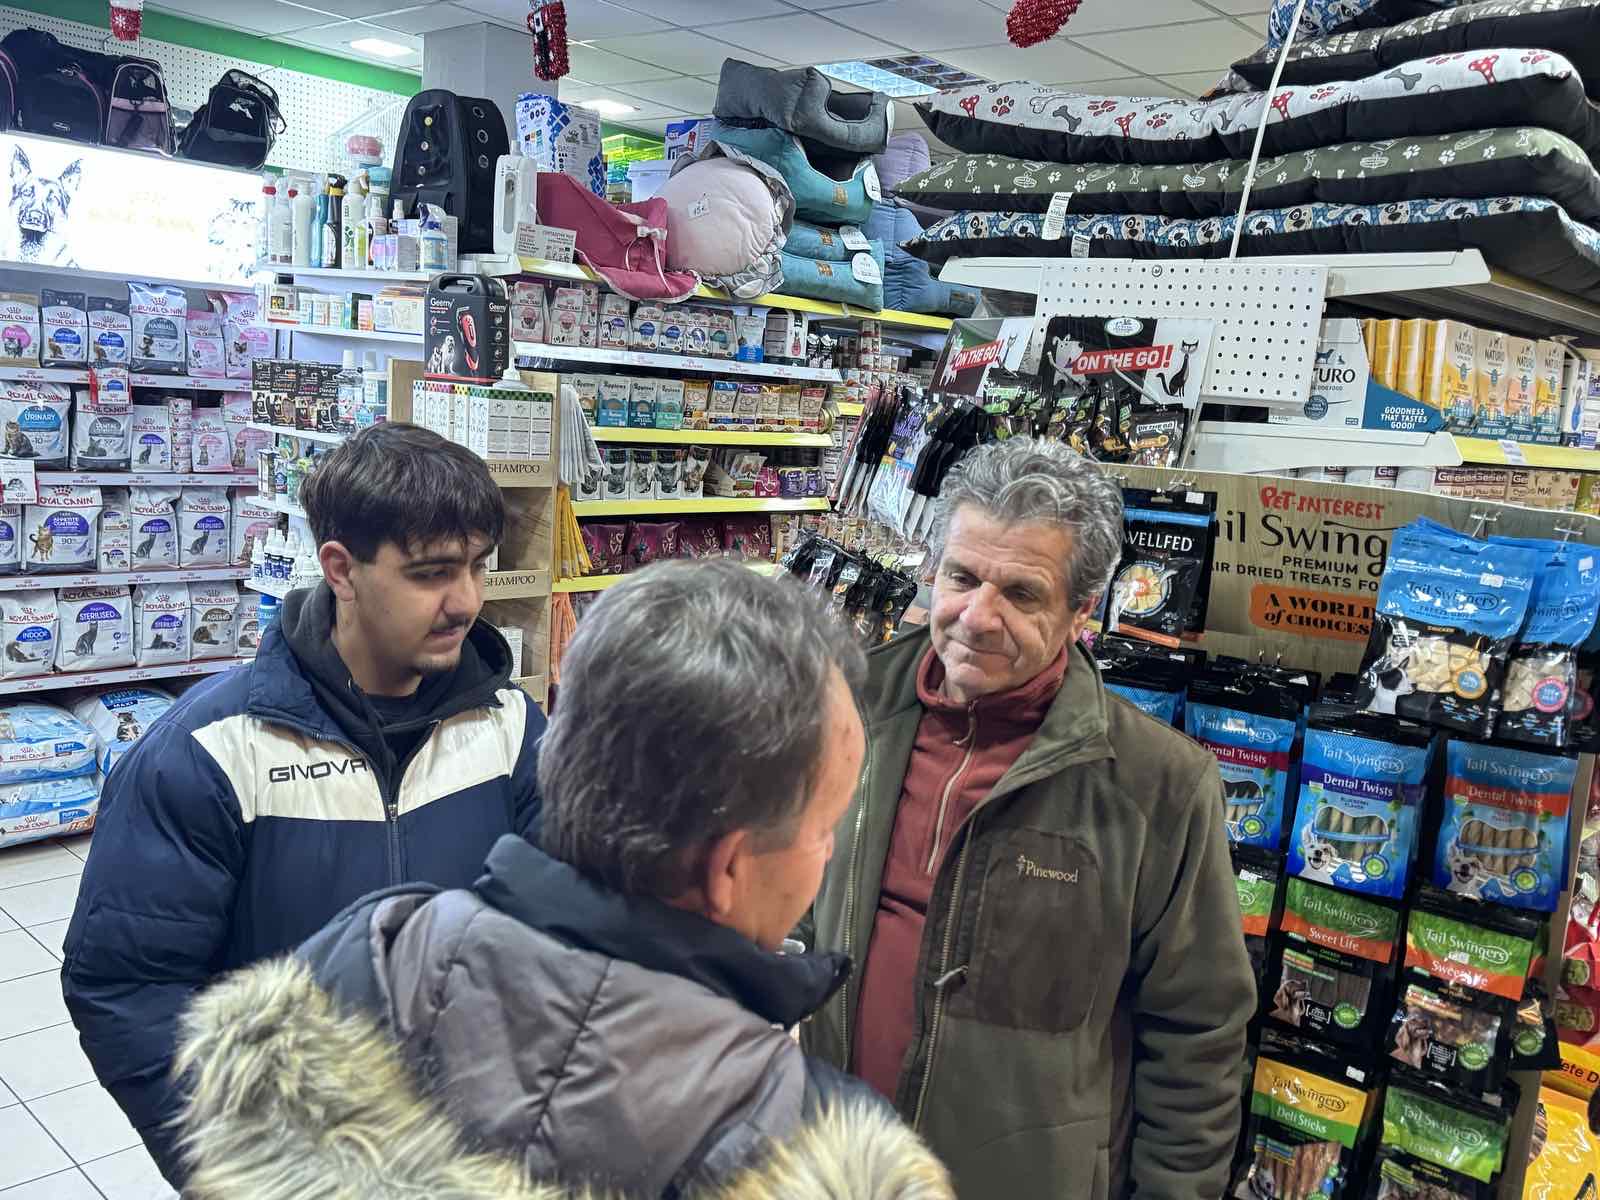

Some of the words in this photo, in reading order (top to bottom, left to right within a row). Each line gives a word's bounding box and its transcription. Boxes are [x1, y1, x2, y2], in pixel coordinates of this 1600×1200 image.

[955, 354, 964, 368] ON
[965, 350, 981, 365] THE
[1077, 355, 1100, 371] ON
[1104, 352, 1133, 369] THE
[1313, 368, 1356, 383] TURO
[25, 411, 55, 421] URINARY
[1381, 413, 1398, 422] THAT
[1399, 415, 1428, 424] TASTES
[1384, 406, 1425, 415] GOODNESS
[1391, 422, 1415, 430] GOOD!
[488, 463, 541, 474] SHAMPOO
[40, 497, 62, 506] OYAL
[64, 497, 94, 506] CANIN
[1121, 529, 1193, 552] WELLFED
[1261, 514, 1388, 577] Swing
[1282, 556, 1359, 575] PREMIUM
[484, 575, 536, 587] SHAMPOO
[1211, 562, 1230, 573] IR
[1237, 564, 1283, 579] DRIED
[1289, 571, 1351, 588] TREATS
[1358, 580, 1378, 592] FO
[1408, 581, 1431, 596] Tail
[1266, 593, 1280, 607] A
[1264, 609, 1284, 624] of
[1286, 613, 1369, 635] CHOICES
[1203, 743, 1235, 758] Dental
[1237, 749, 1267, 764] Twists
[1323, 745, 1343, 761] Tail
[1345, 751, 1401, 773] Swingers
[269, 758, 369, 783] GIVOVA
[1467, 758, 1487, 772] Tail
[1490, 761, 1552, 785] Swingers
[1324, 773, 1359, 790] Dental
[1360, 780, 1393, 797] Twists
[1468, 784, 1505, 800] Dental
[1026, 860, 1079, 883] Pinewood
[1303, 896, 1323, 912] Tail
[1324, 903, 1377, 929] Swingers
[1309, 927, 1338, 945] Sweet
[1339, 937, 1360, 951] Life
[1425, 929, 1446, 944] Tail
[1449, 934, 1509, 962] Swingers
[1272, 1075, 1292, 1090] Tail
[1293, 1082, 1346, 1109] Swingers
[1277, 1105, 1298, 1122] Deli
[1299, 1113, 1329, 1134] Sticks
[1404, 1105, 1422, 1122] Tail
[1424, 1116, 1480, 1142] Swingers
